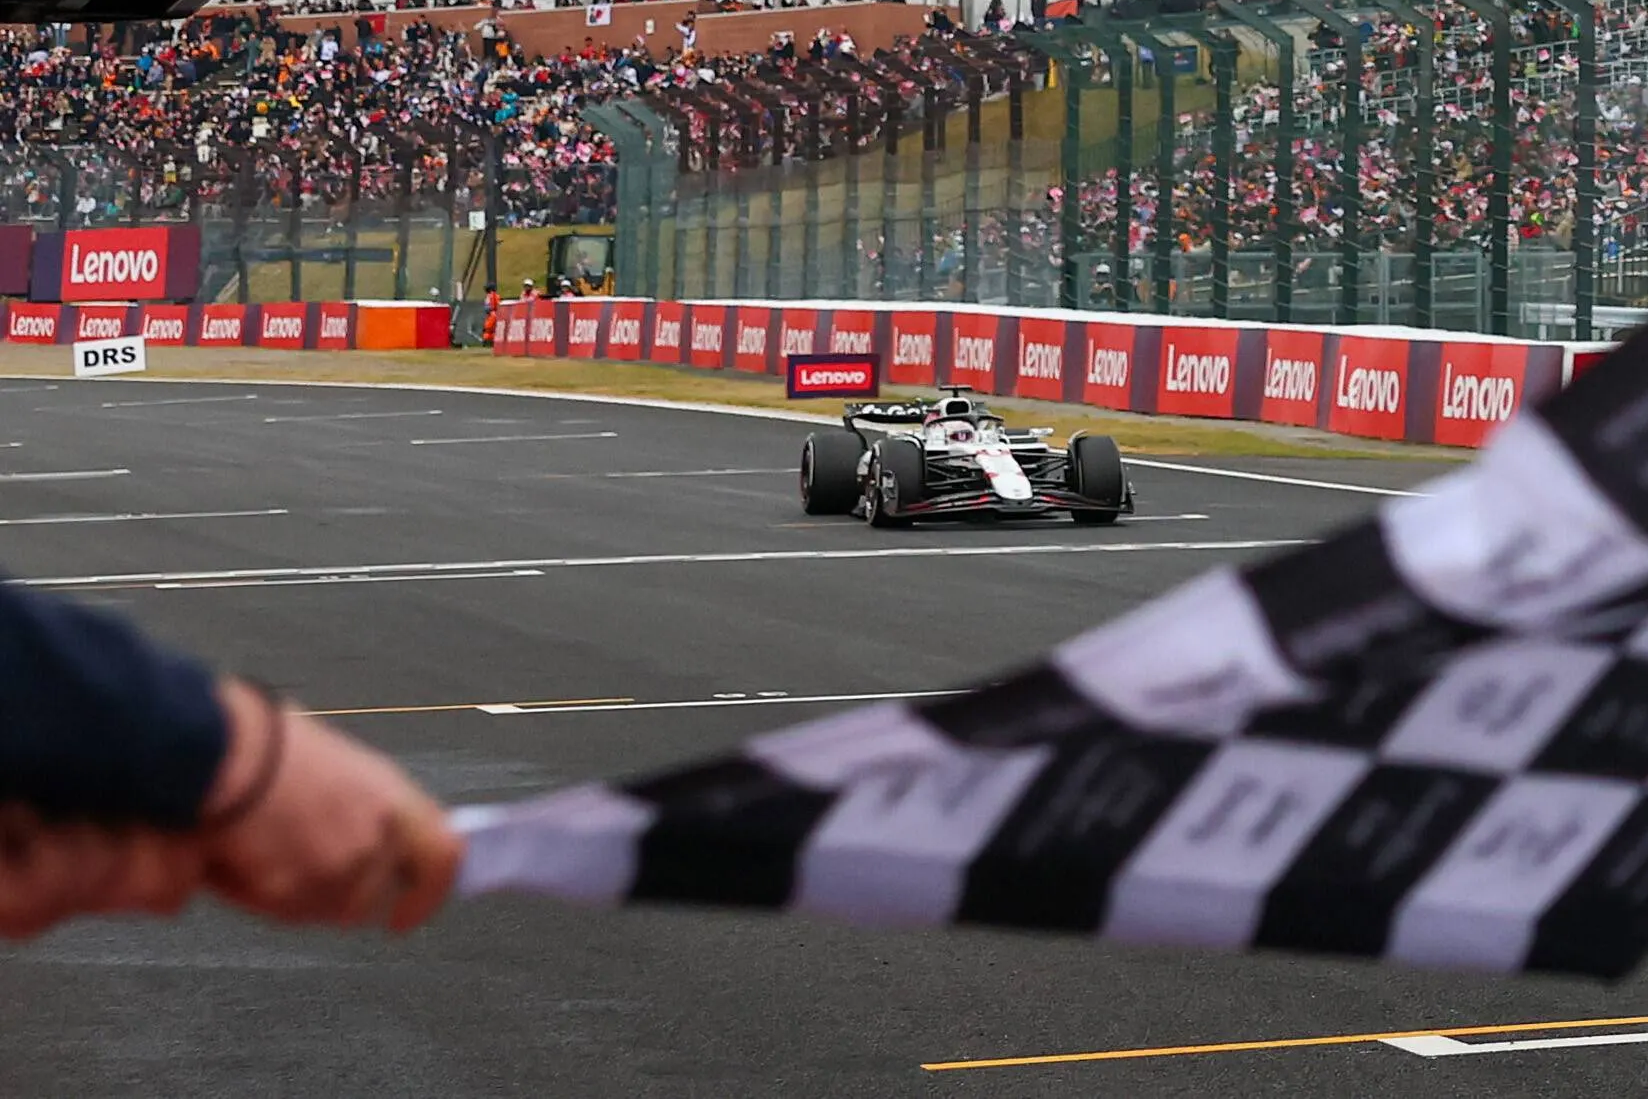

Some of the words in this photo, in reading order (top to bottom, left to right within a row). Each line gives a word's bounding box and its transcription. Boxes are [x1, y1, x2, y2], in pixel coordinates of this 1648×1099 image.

[70, 243, 158, 283] Lenovo
[10, 312, 55, 336] Lenovo
[79, 313, 121, 337] Lenovo
[143, 314, 183, 338] Lenovo
[202, 313, 240, 339] Lenovo
[263, 312, 302, 338] Lenovo
[84, 346, 136, 367] DRS
[1019, 332, 1062, 379] Lenovo
[1087, 339, 1128, 387] Lenovo
[1166, 344, 1230, 394] Lenovo
[801, 369, 866, 385] Lenovo
[1264, 348, 1316, 401] Lenovo
[1337, 354, 1399, 414] Lenovo
[1442, 362, 1515, 422] Lenovo
